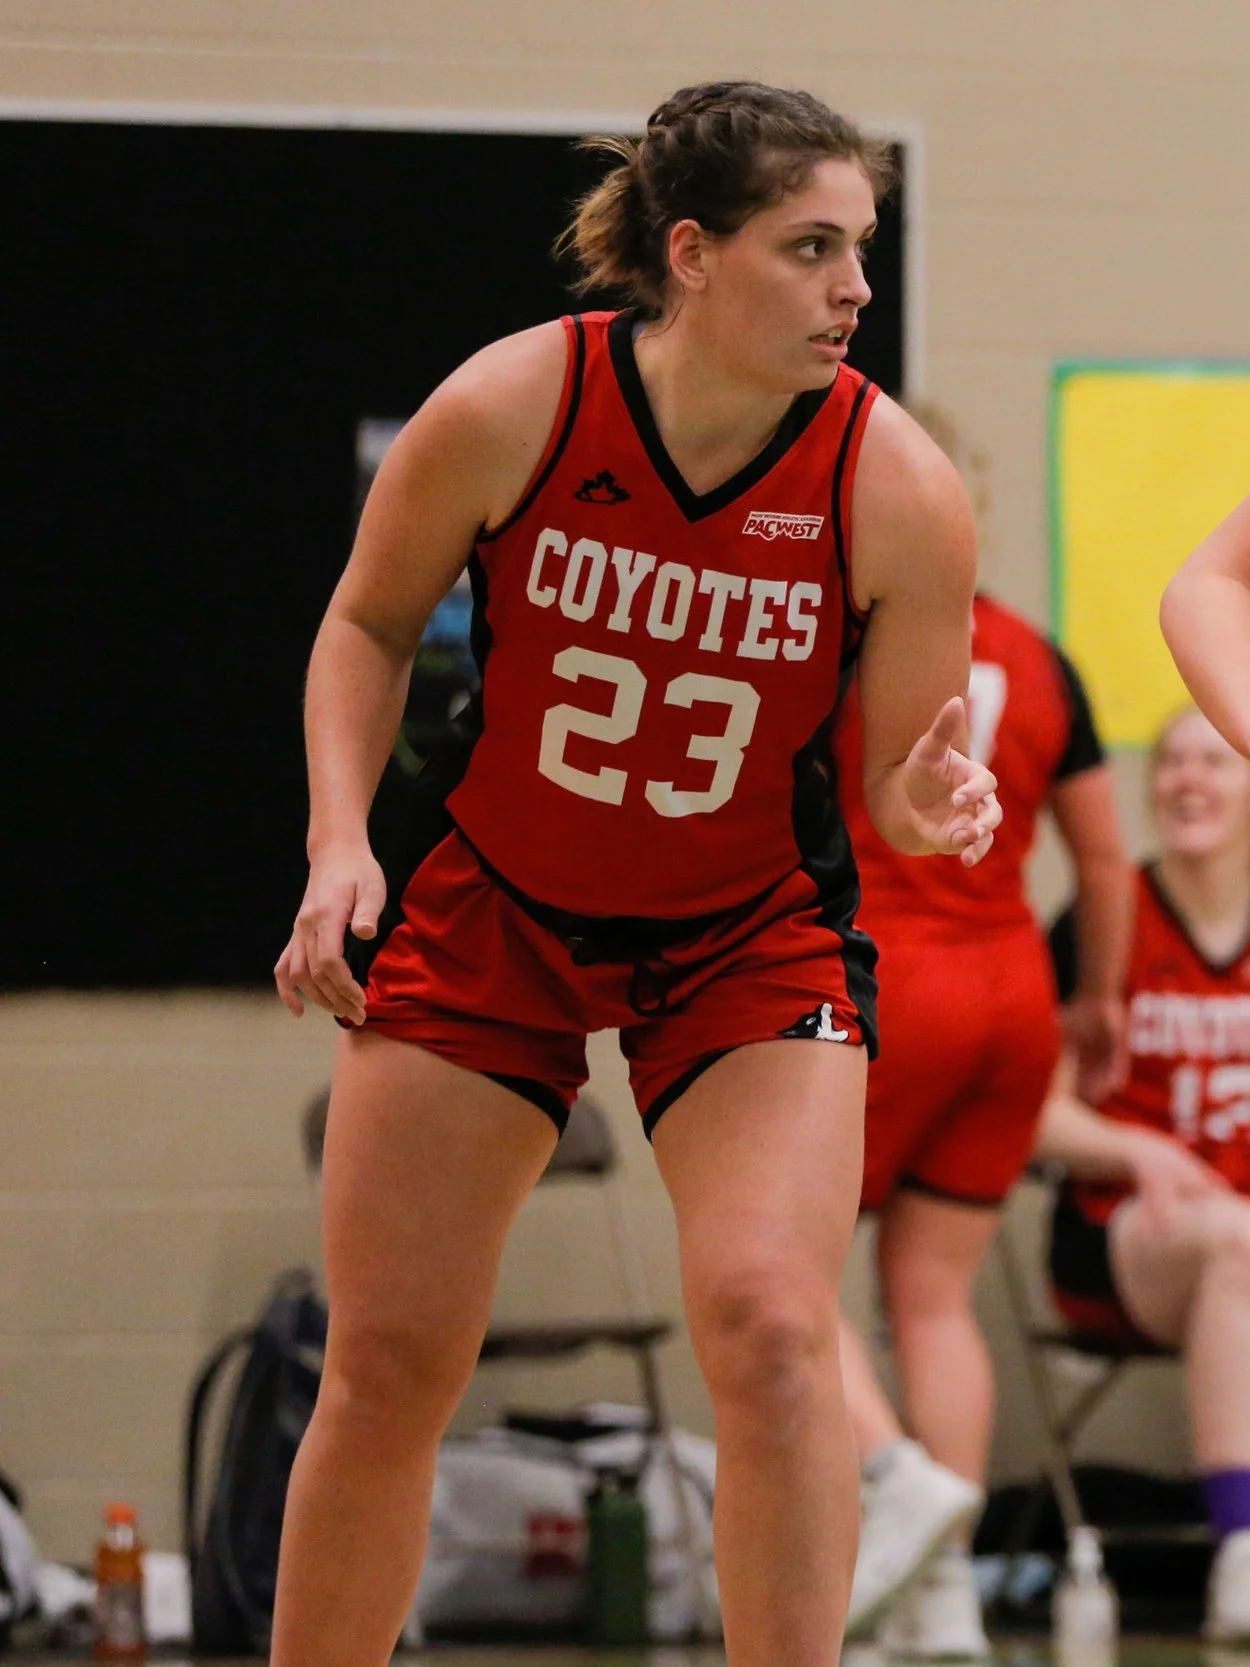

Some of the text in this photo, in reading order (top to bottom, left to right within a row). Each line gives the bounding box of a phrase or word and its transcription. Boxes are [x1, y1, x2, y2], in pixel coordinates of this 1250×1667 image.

[526, 528, 823, 661] COYOTES
[744, 519, 820, 538] PACWEST
[538, 646, 761, 818] 23
